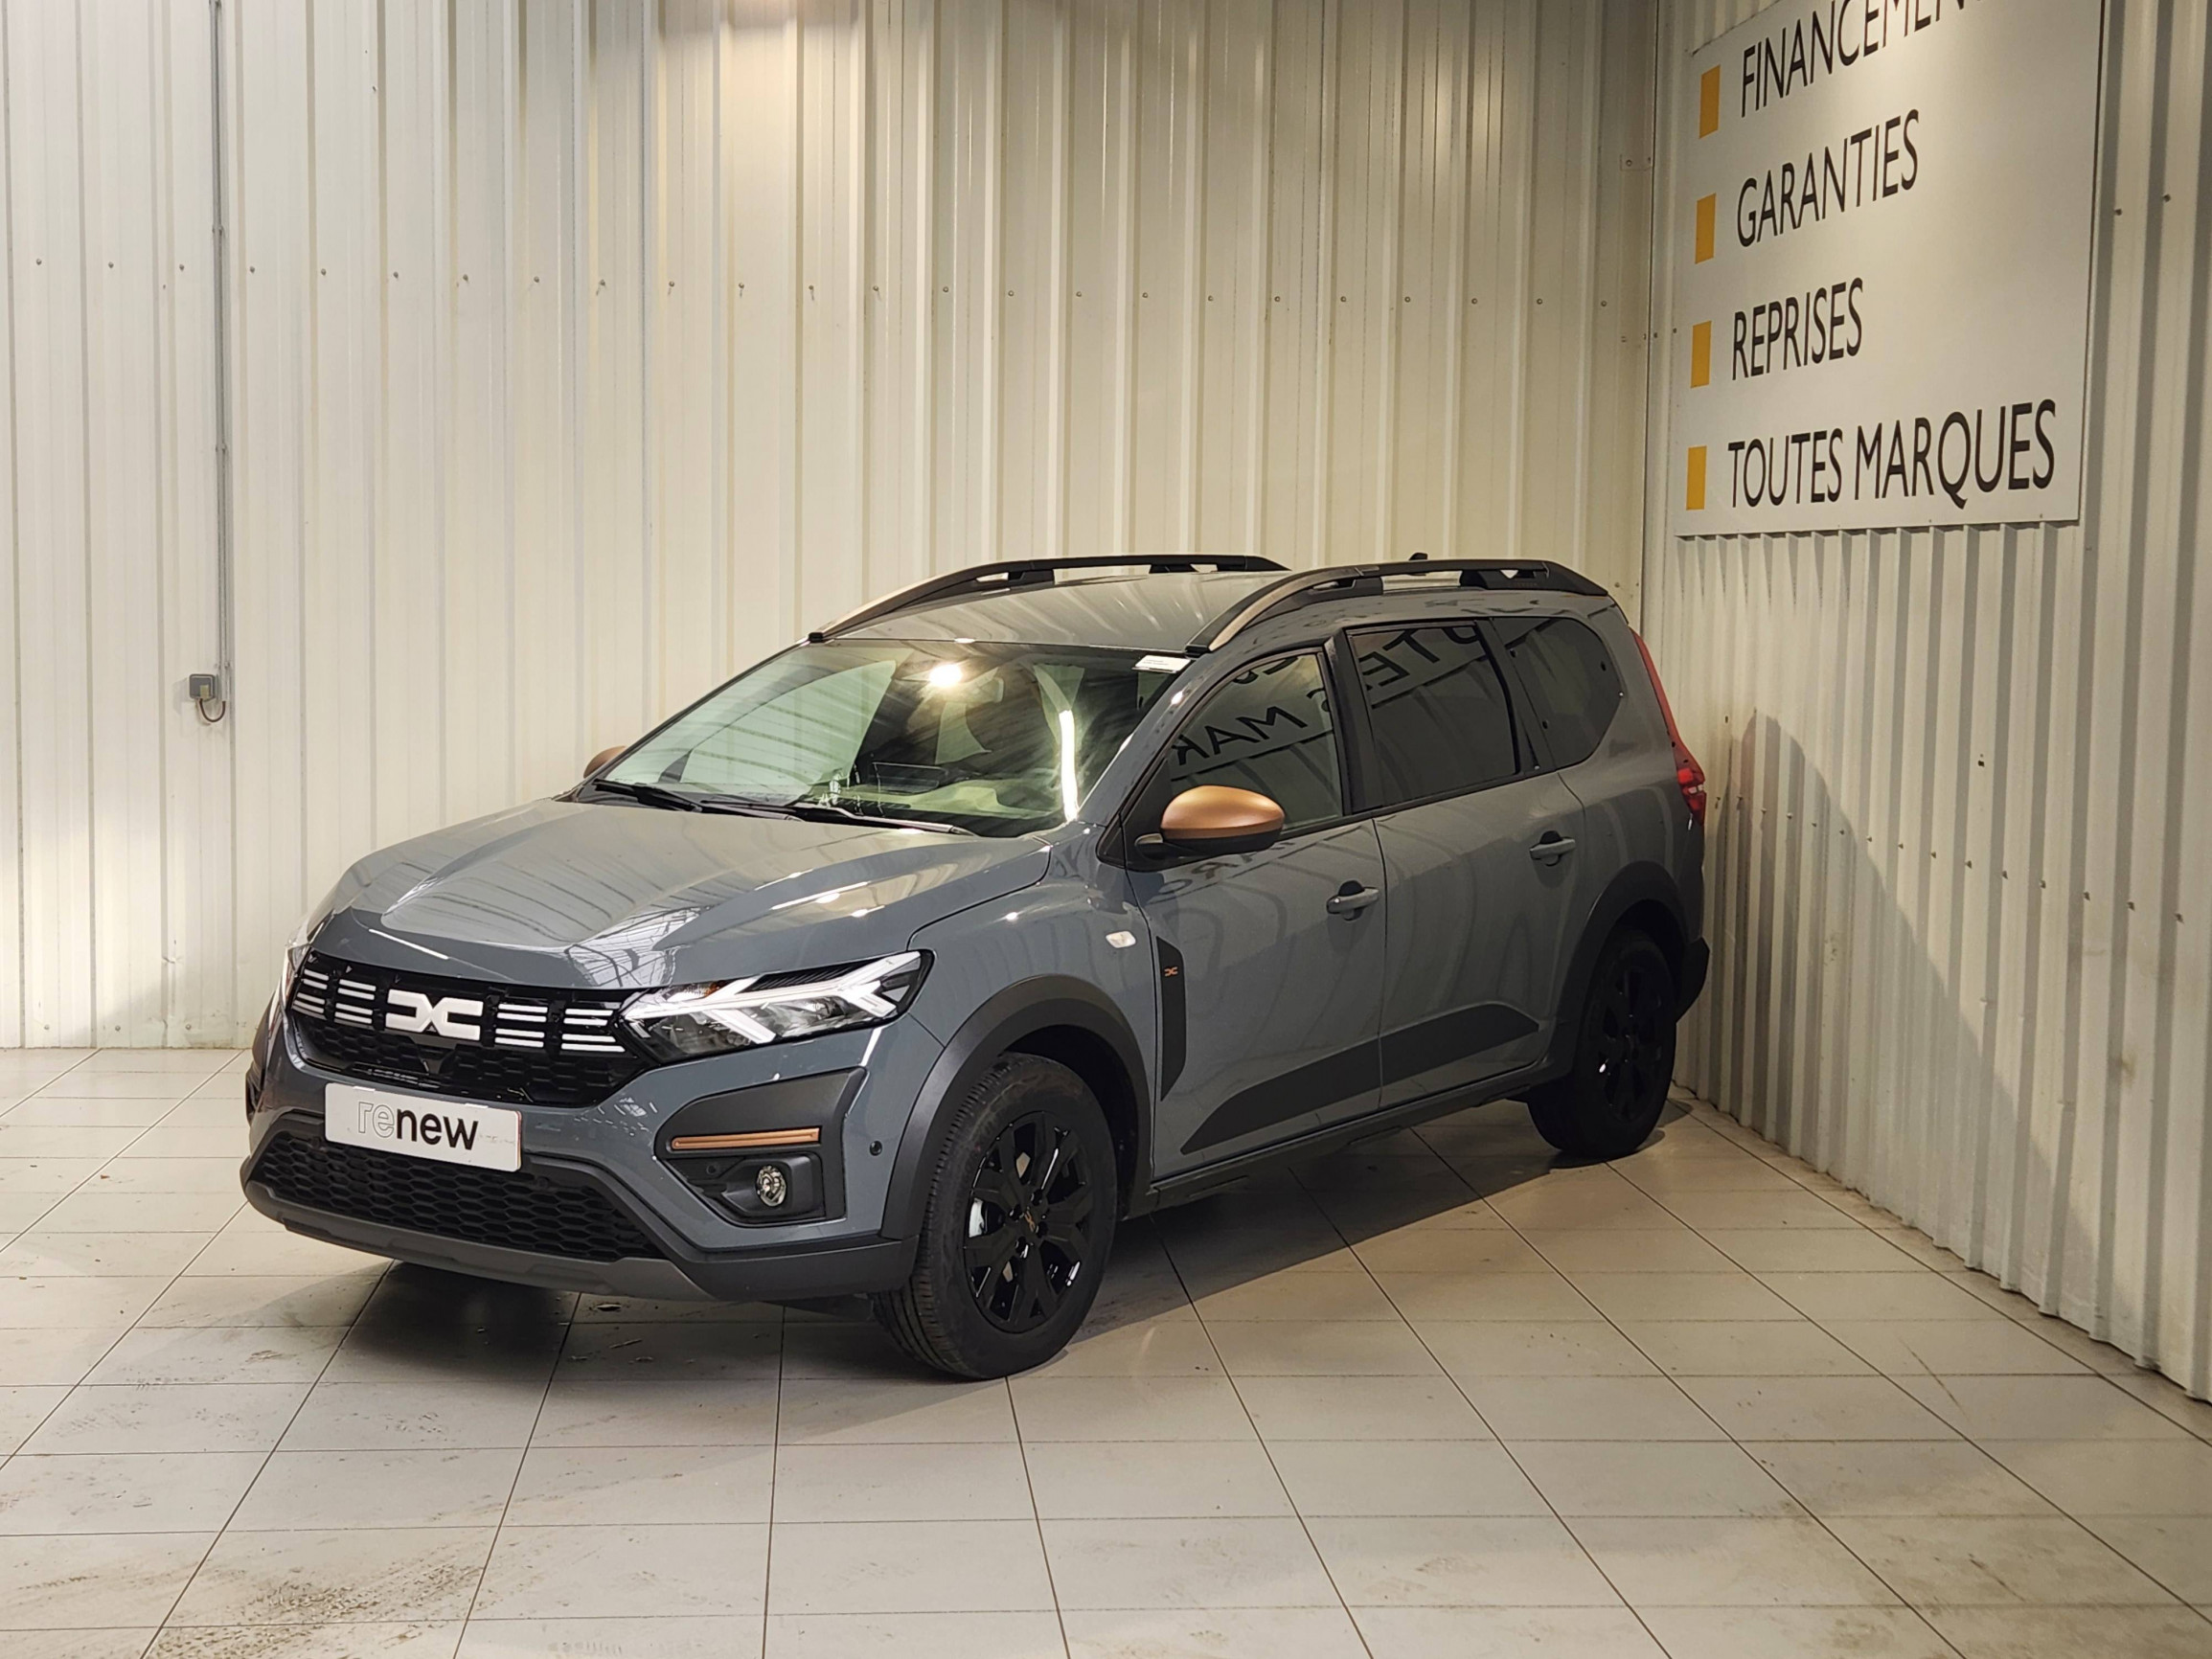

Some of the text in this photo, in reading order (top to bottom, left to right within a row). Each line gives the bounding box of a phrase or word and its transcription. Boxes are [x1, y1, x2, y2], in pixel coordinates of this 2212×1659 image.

[1741, 0, 1965, 118] FINANCEM
[1737, 108, 1920, 248] GARANTIES
[1732, 278, 1863, 381] REPRISES
[1727, 398, 2057, 510] TOUTES MARQUES
[358, 1102, 479, 1151] renew
